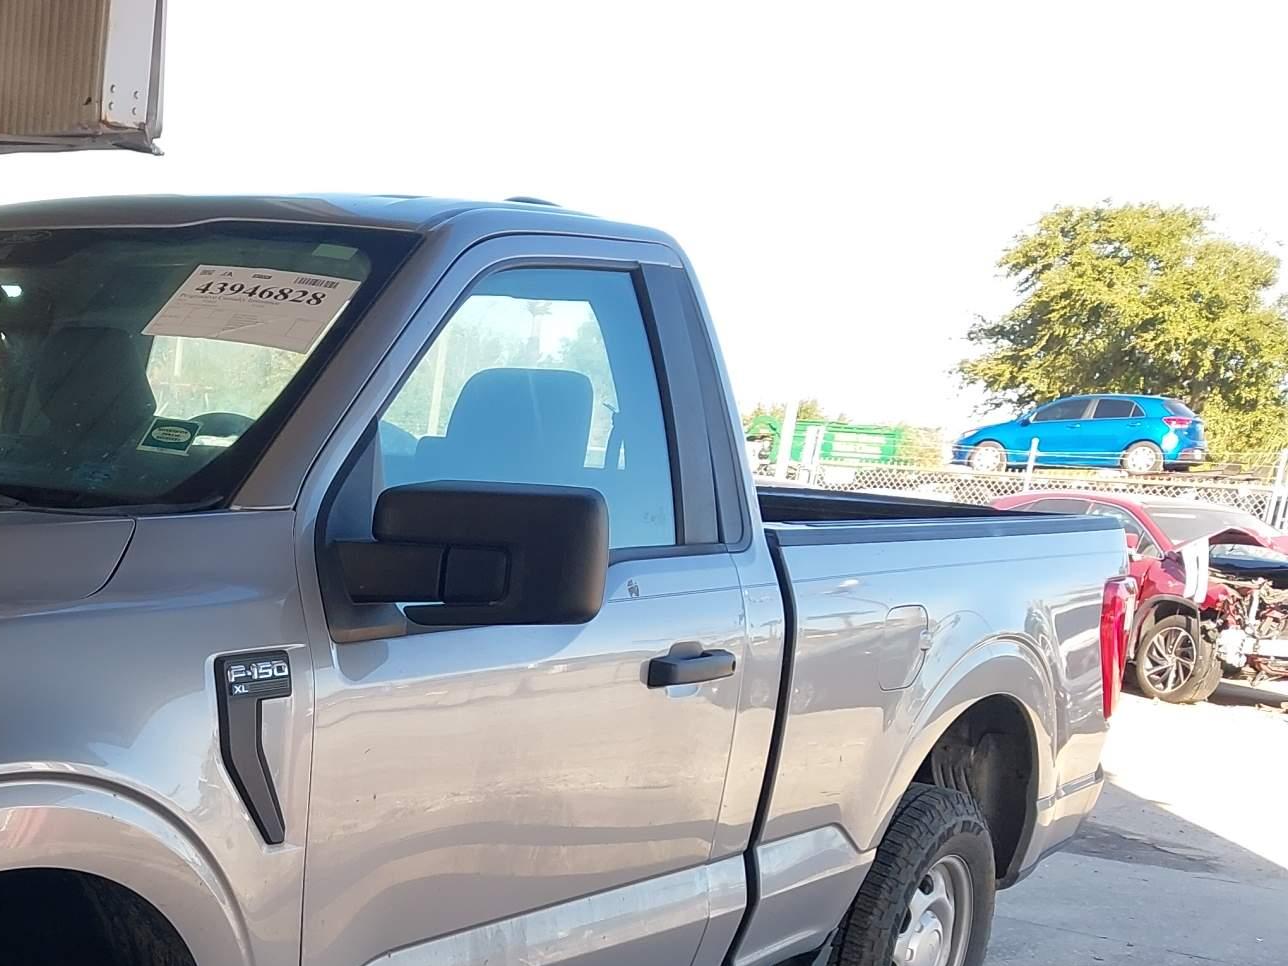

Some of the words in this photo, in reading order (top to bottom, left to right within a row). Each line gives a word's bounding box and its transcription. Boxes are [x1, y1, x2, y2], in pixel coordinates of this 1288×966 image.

[195, 281, 326, 306] 43946828
[227, 660, 289, 682] F-150
[233, 684, 249, 694] XL
